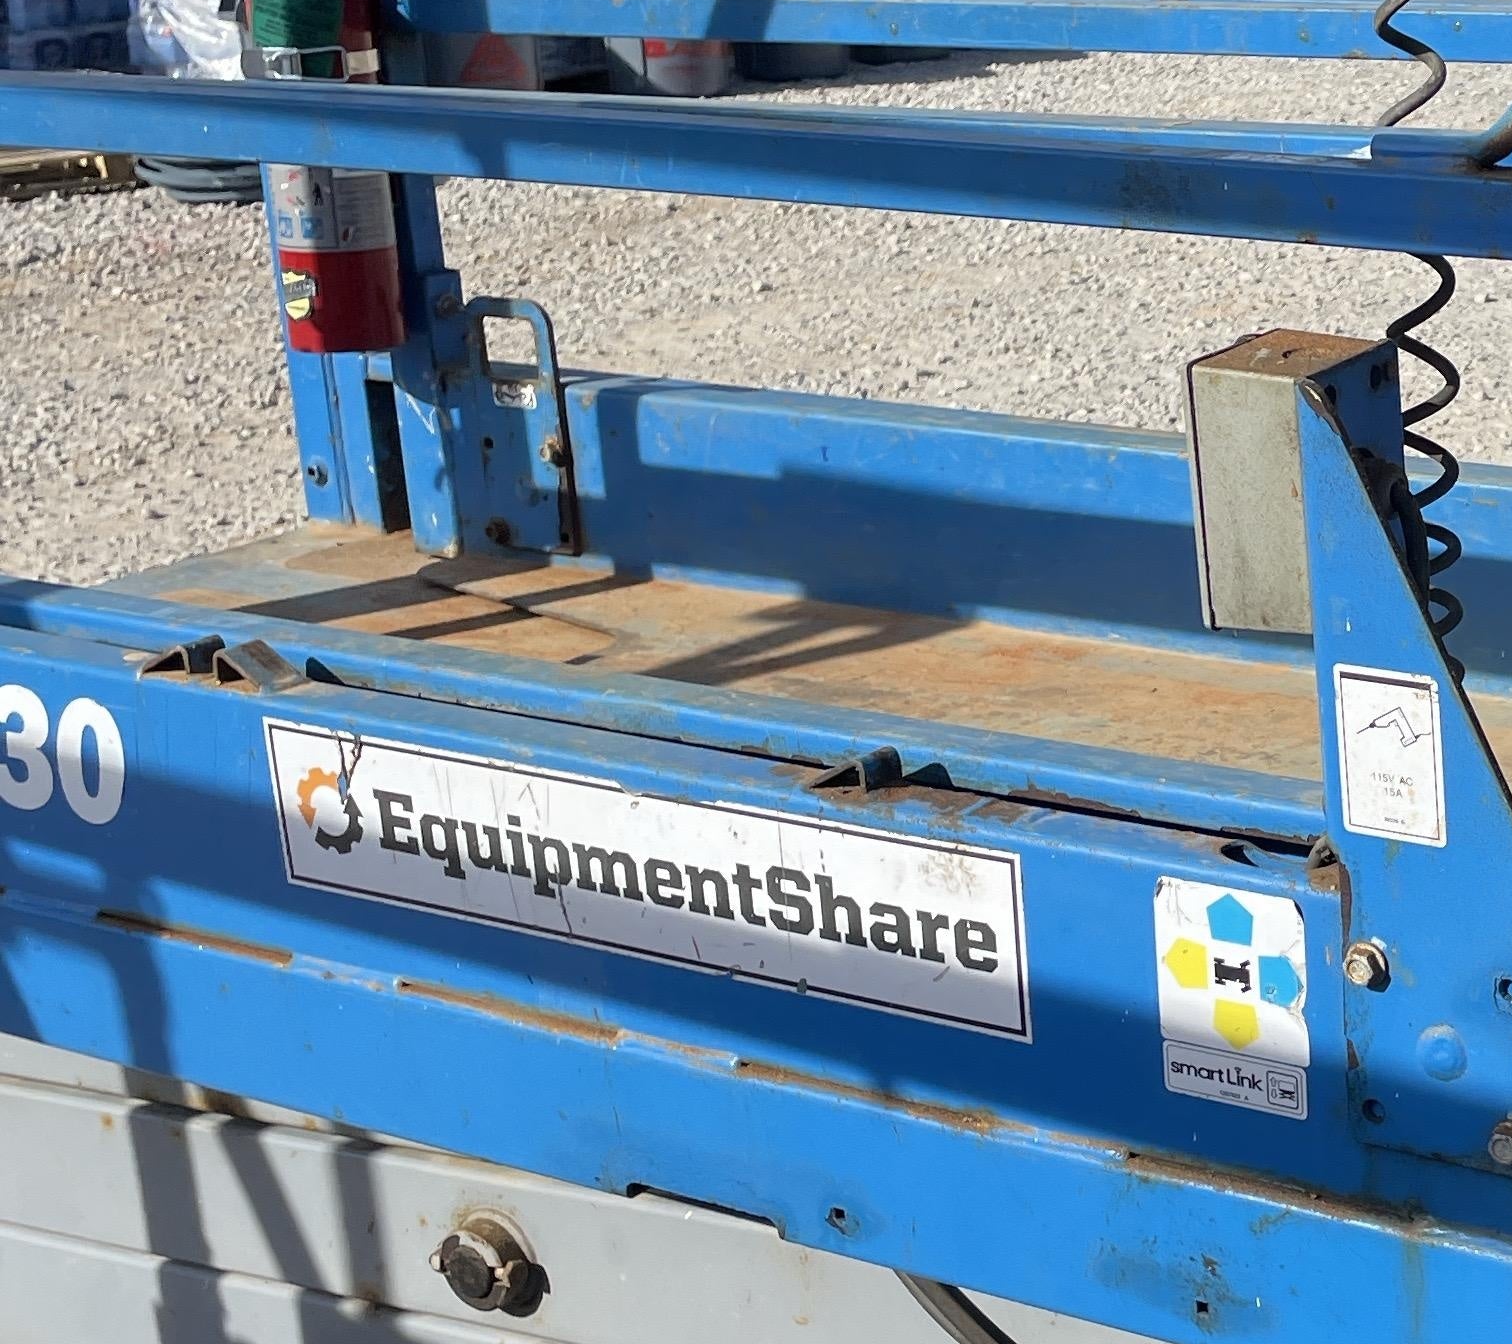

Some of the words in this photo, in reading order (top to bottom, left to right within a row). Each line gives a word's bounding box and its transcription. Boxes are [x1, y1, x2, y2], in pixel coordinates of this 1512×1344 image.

[0, 683, 126, 825] 30
[1383, 787, 1403, 798] 15A
[1399, 775, 1414, 787] AC
[372, 787, 1001, 974] EquipmentShare
